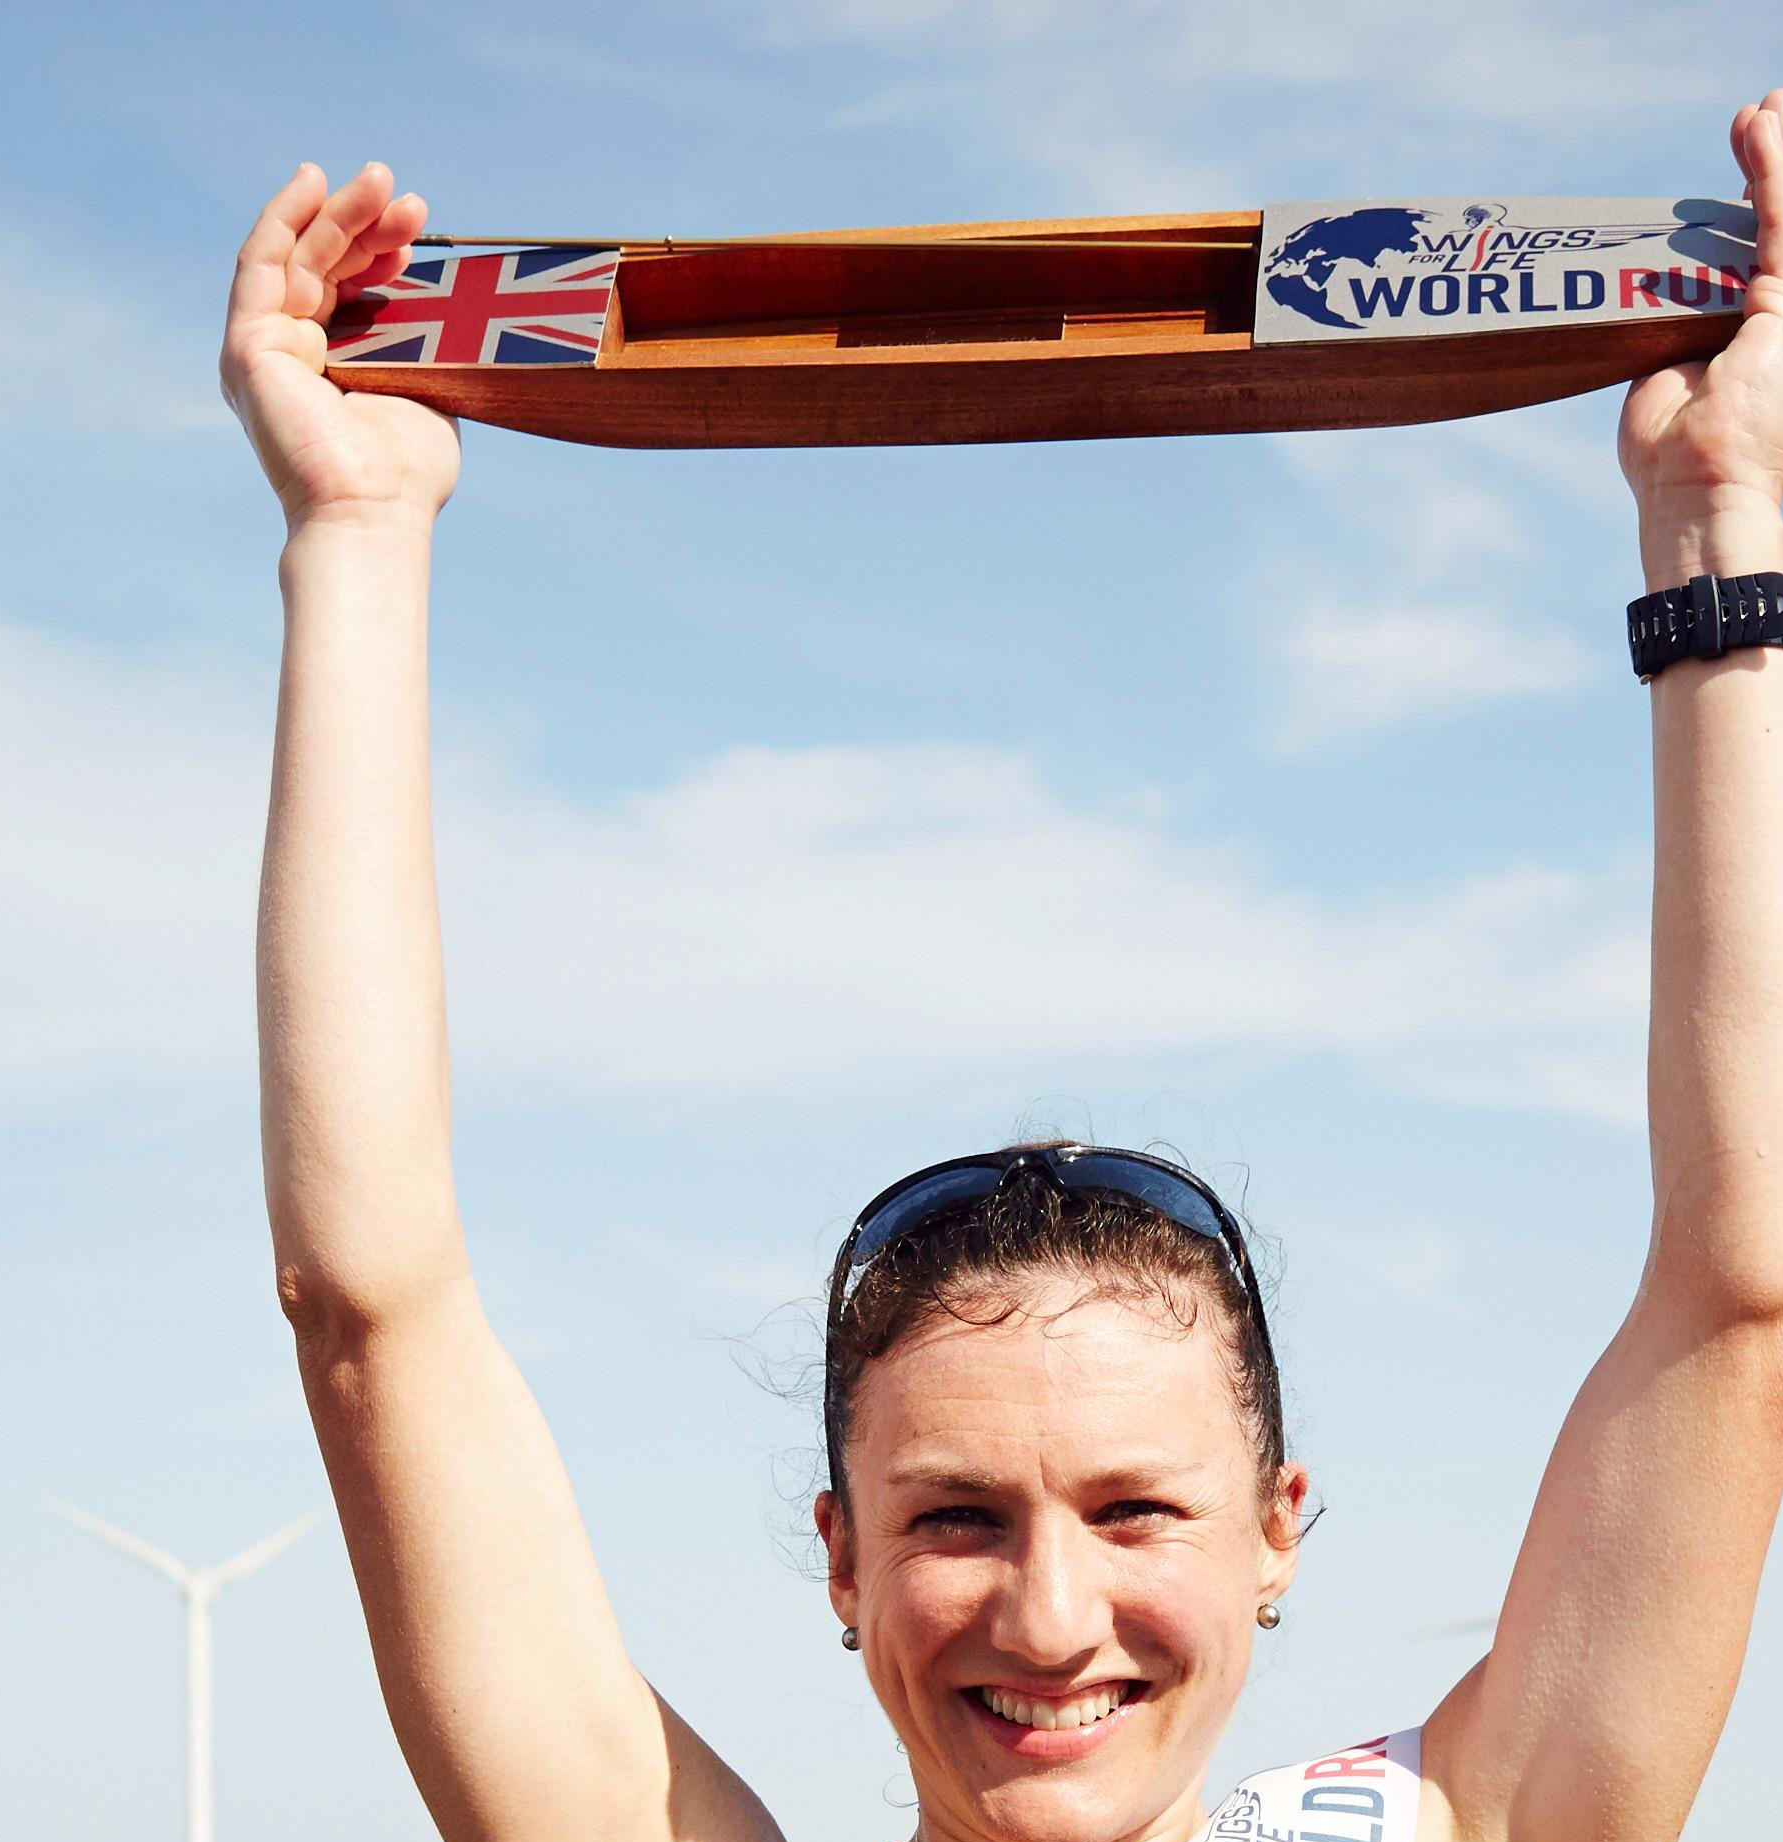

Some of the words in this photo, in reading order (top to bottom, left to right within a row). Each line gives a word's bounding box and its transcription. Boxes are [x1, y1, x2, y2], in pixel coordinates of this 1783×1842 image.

[1421, 225, 1596, 253] WINGS
[1408, 253, 1445, 265] FOR
[1441, 250, 1545, 272] LIFE
[1349, 269, 1605, 318] WORLD
